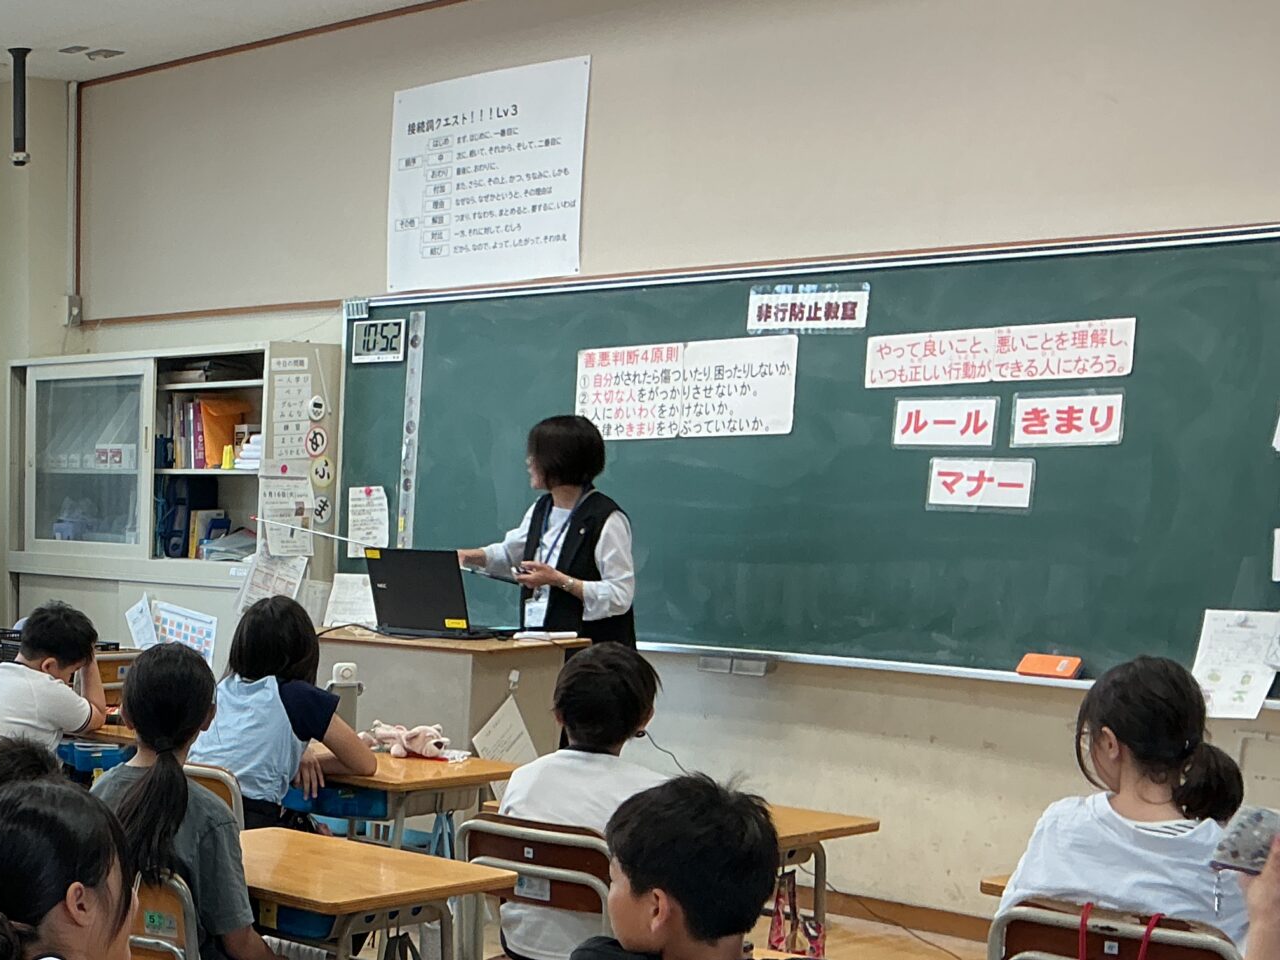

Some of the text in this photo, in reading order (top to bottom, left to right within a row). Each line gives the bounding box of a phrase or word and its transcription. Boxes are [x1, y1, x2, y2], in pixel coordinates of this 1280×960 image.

[756, 301, 858, 323] 非行防止教室
[901, 409, 988, 436] ルール
[1022, 405, 1114, 435] きまり
[937, 470, 1024, 497] マナー
